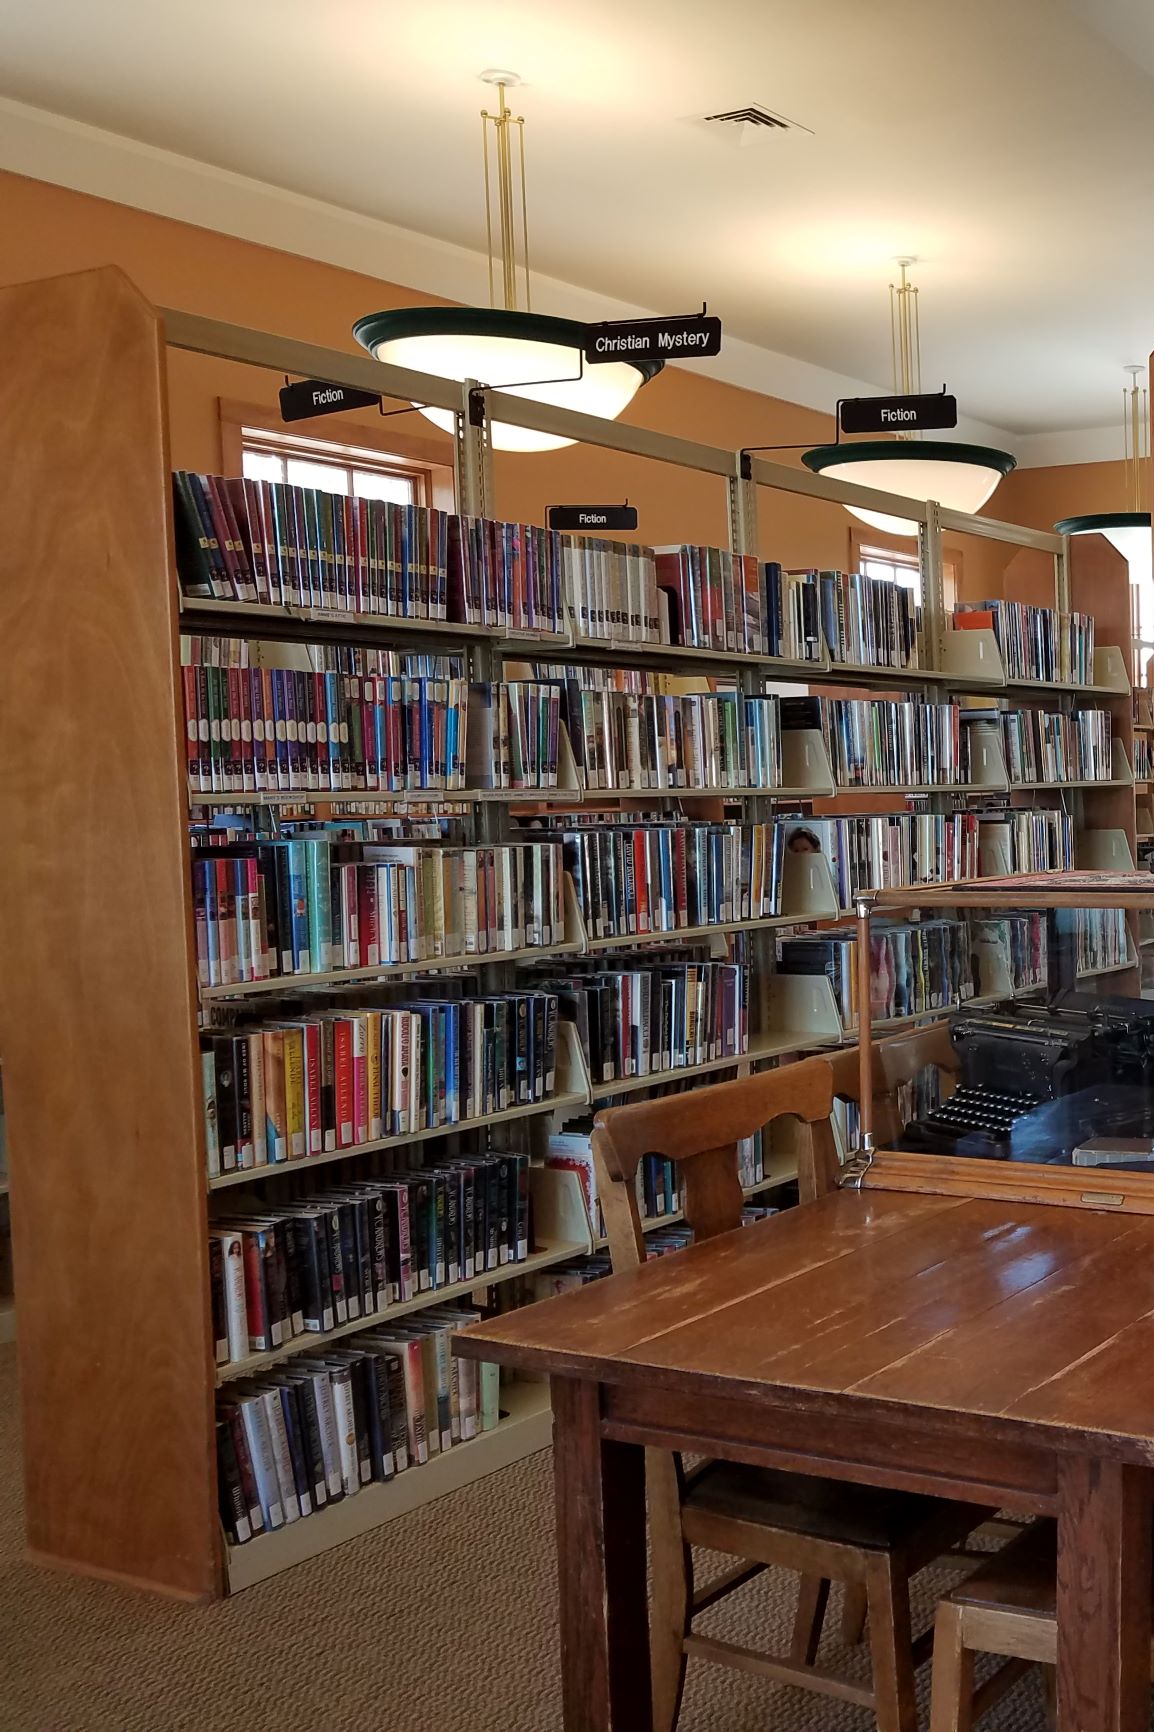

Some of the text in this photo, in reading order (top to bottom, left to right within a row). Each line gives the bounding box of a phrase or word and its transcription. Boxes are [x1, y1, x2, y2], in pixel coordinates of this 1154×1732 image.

[595, 331, 710, 352] Christian Mystery
[312, 389, 344, 405] Fiction
[881, 408, 917, 422] Fiction
[579, 513, 607, 524] Fiction
[358, 1024, 366, 1052] Zorro
[450, 1367, 458, 1394] ARCHER
[346, 1408, 354, 1432] ARCHER
